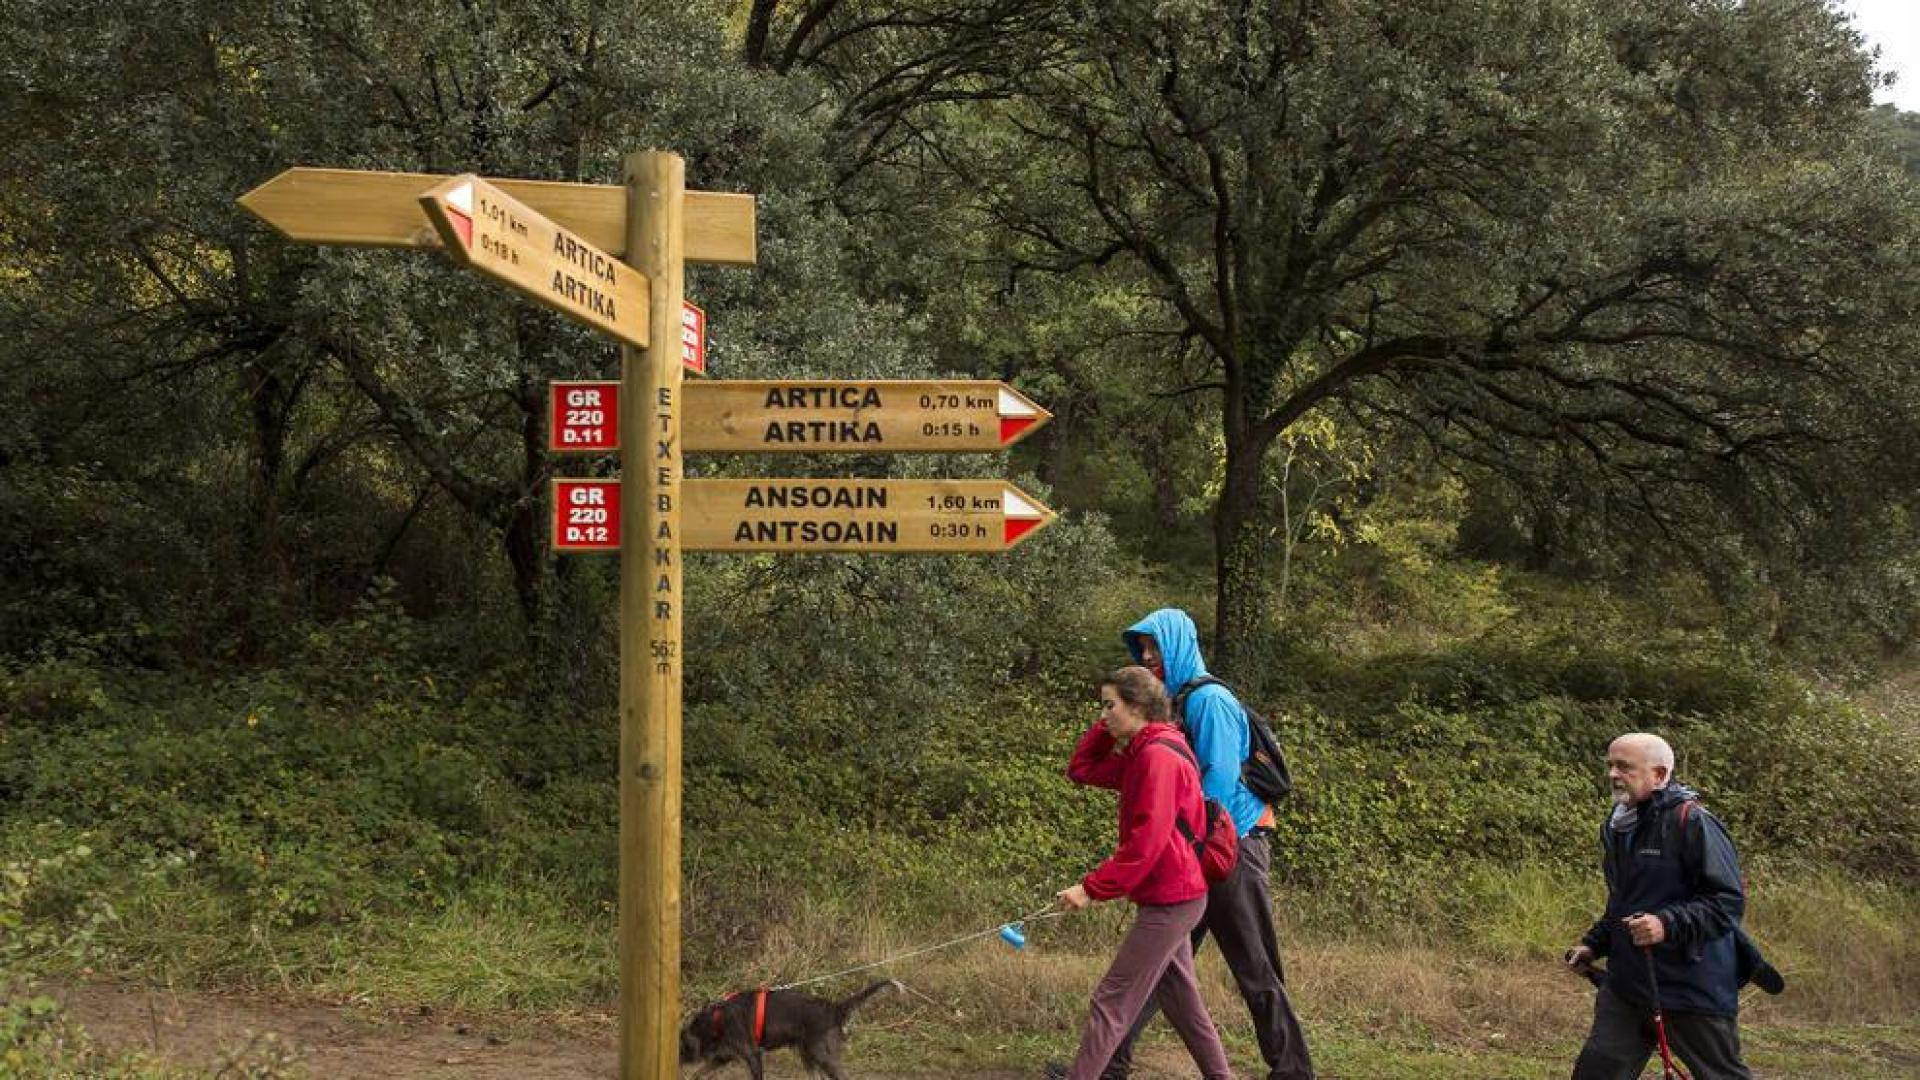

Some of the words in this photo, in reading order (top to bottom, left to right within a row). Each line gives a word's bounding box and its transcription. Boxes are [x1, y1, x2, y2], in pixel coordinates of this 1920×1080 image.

[510, 214, 528, 237] km
[511, 249, 519, 265] h
[554, 232, 615, 285] ARTICA
[553, 270, 615, 321] ARTIKA
[567, 389, 602, 407] GR
[765, 387, 882, 408] ARTICA
[920, 394, 959, 410] 0,70
[965, 394, 993, 409] km
[566, 410, 604, 425] 220
[563, 428, 603, 443] D.11
[764, 421, 882, 442] ARTIKA
[922, 422, 963, 436] 0:15
[969, 423, 979, 436] h
[570, 487, 605, 505] GR
[655, 387, 672, 620] ETXEBAKAR
[744, 486, 887, 508] ANSOAIN
[926, 495, 966, 511] 1,60
[972, 495, 1000, 509] km
[568, 508, 608, 524] 220
[566, 526, 608, 542] D.12
[734, 521, 897, 543] ANTSOAIN
[930, 522, 969, 538] 0:30
[976, 523, 987, 537] h
[657, 663, 672, 675] m
